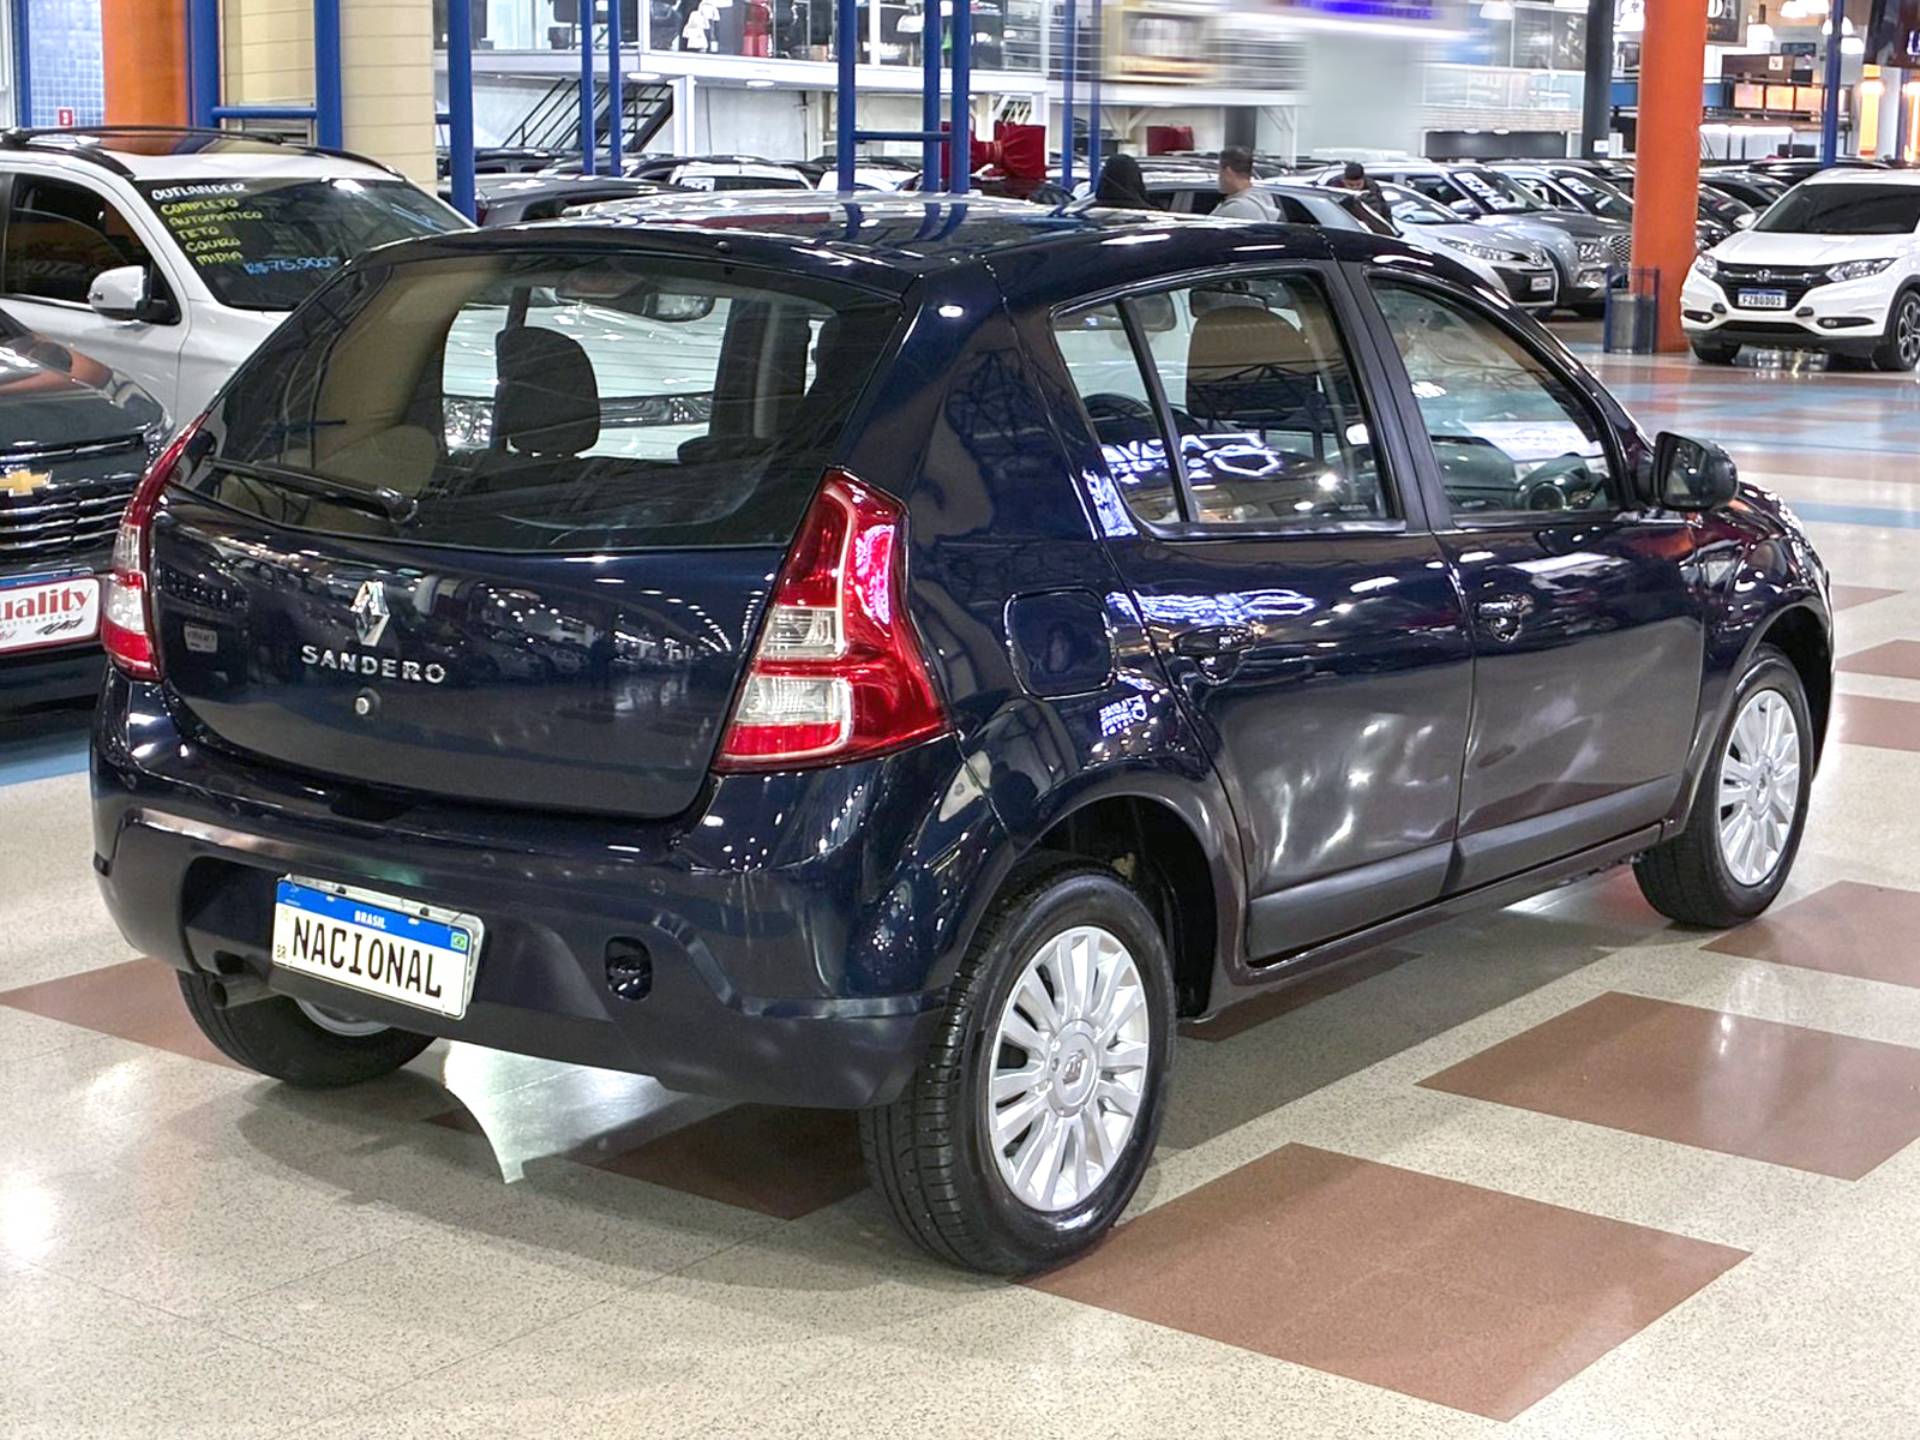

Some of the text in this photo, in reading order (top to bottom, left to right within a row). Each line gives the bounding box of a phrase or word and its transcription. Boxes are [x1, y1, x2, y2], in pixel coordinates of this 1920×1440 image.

[151, 182, 250, 201] OUTLANDER
[160, 198, 239, 216] COMPLETO
[175, 226, 220, 240] TETO
[301, 644, 446, 684] SANDERO
[354, 910, 387, 929] BRASIL
[293, 916, 442, 998] NACIONAL
